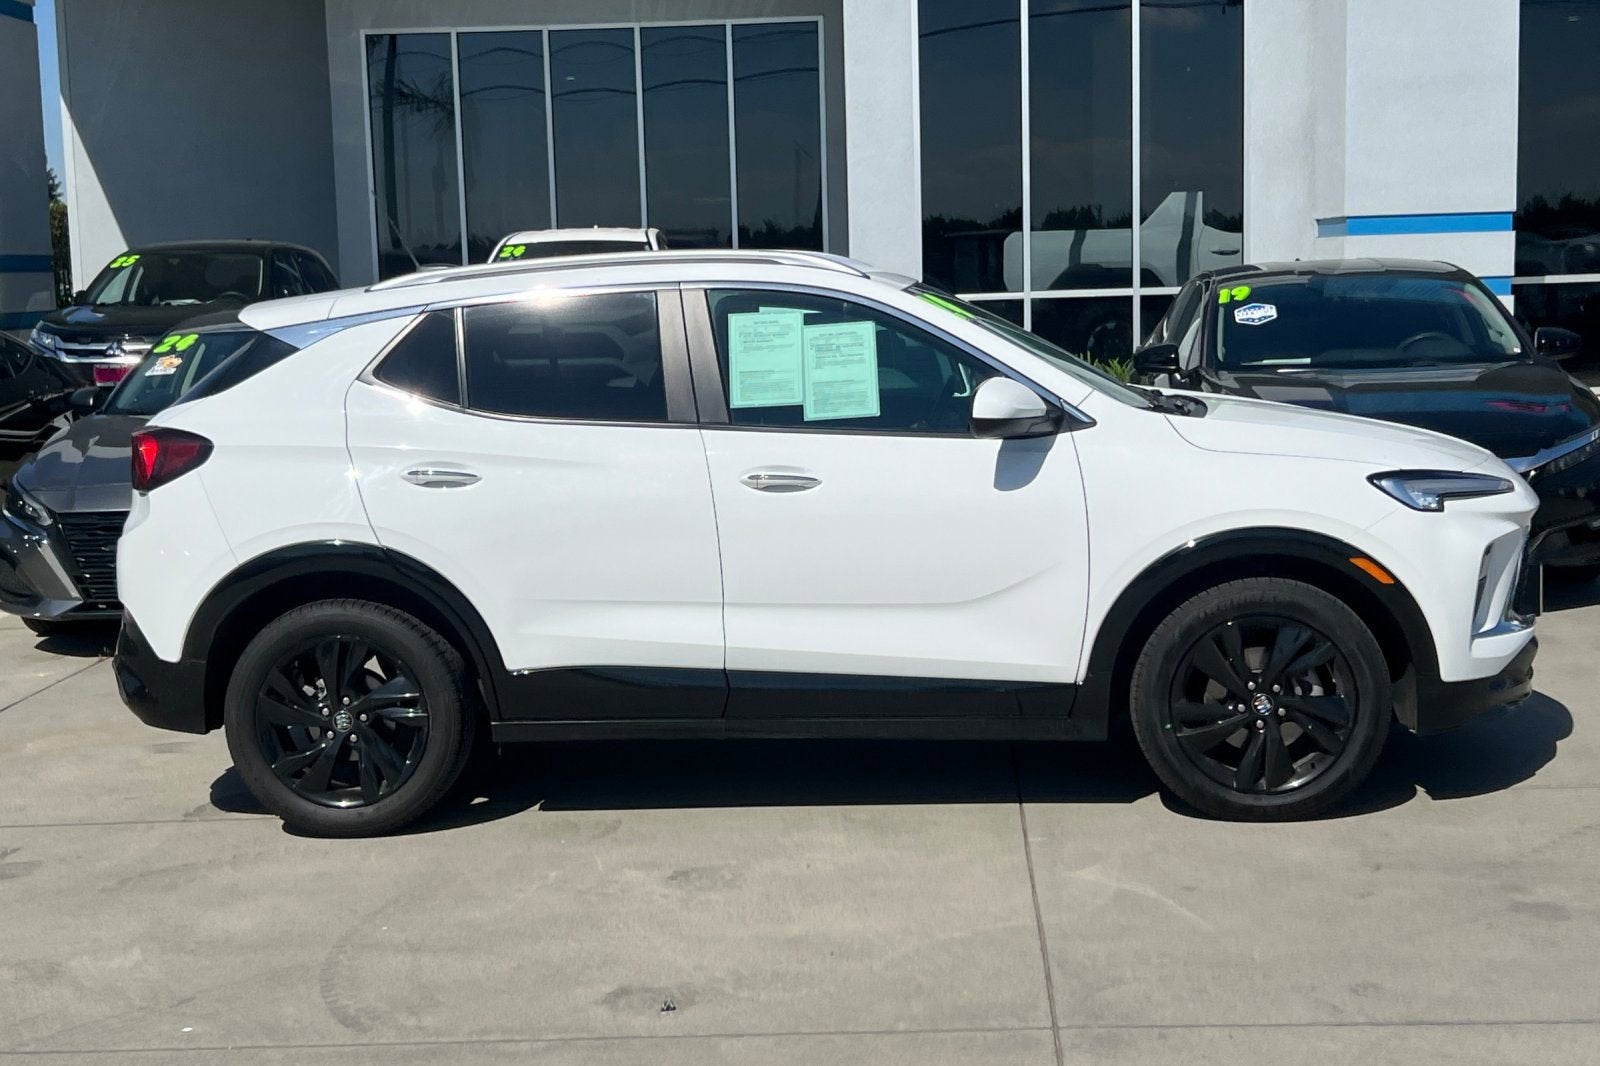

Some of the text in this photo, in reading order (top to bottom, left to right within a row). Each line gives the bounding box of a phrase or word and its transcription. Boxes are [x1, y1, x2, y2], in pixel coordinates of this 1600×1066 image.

[499, 245, 526, 258] 24
[110, 254, 140, 268] 25
[1218, 286, 1252, 304] 19
[153, 333, 199, 353] 24
